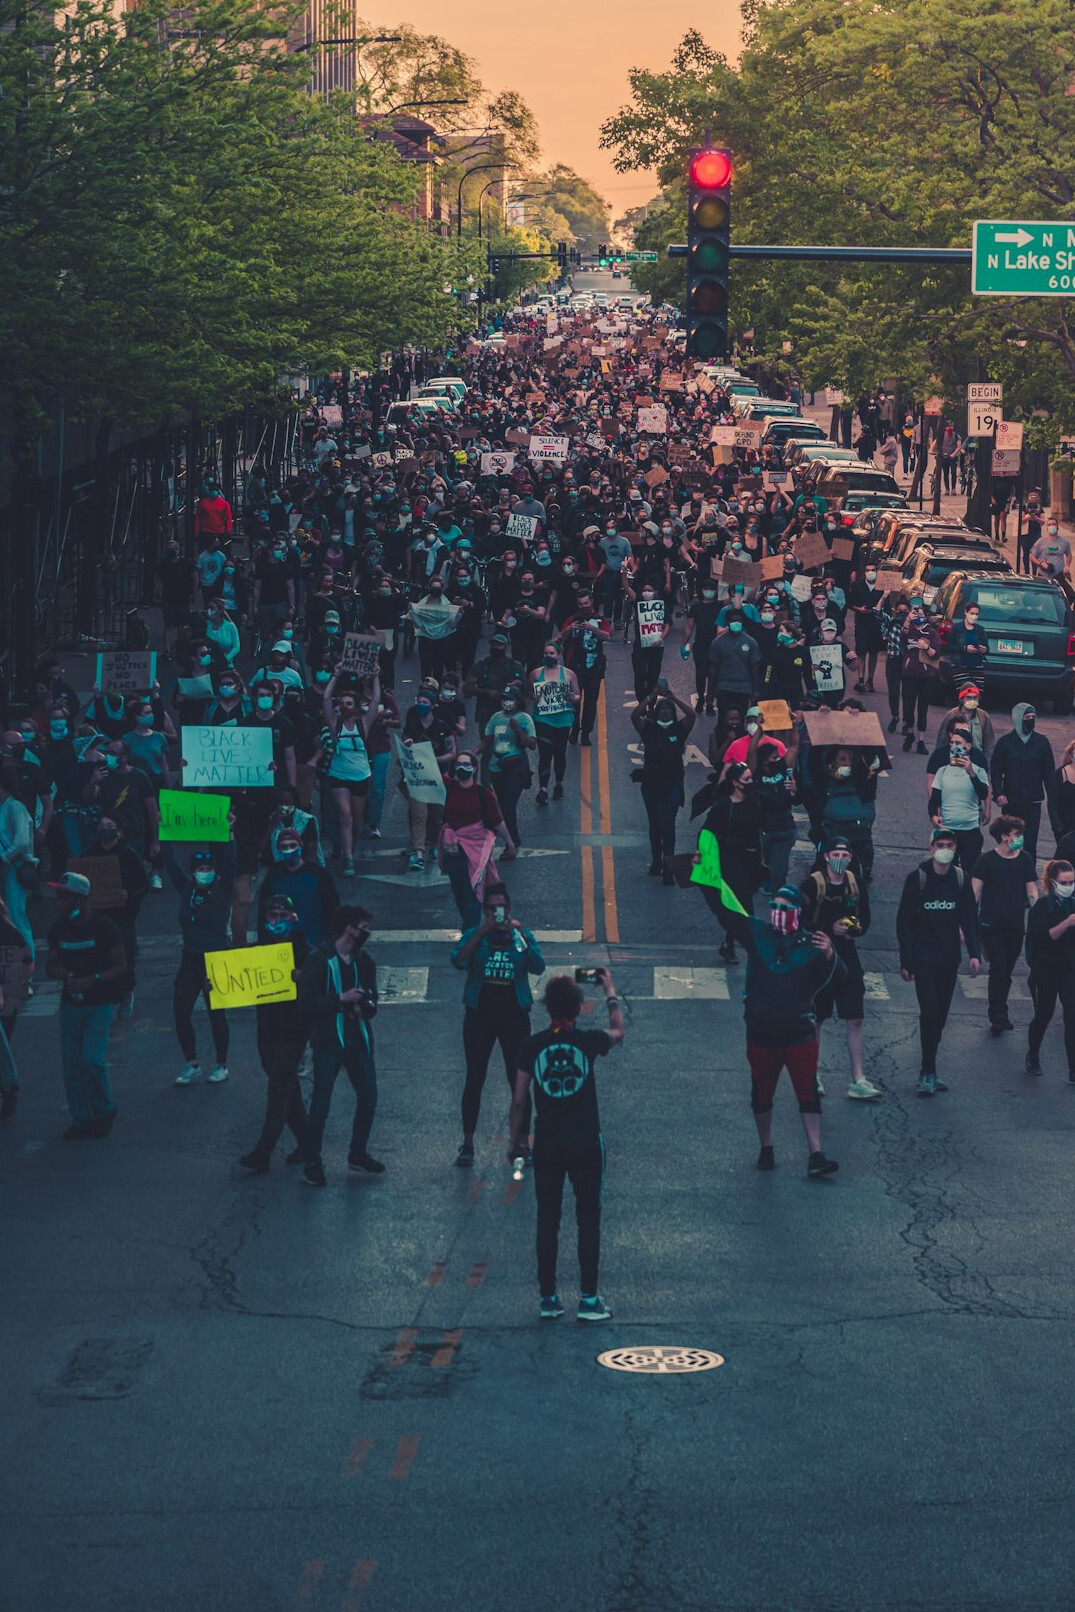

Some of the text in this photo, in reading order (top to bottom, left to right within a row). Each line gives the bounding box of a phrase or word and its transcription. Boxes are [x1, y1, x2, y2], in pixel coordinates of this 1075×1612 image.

[1042, 232, 1053, 247] N
[987, 254, 998, 269] N
[1005, 250, 1051, 270] Lake
[971, 387, 999, 397] BEGIN
[976, 416, 994, 430] 19
[539, 437, 565, 445] SILENCE
[736, 438, 752, 446] CPD
[512, 521, 532, 530] LIVES
[513, 515, 532, 524] BLACK
[507, 526, 531, 538] MATTER
[639, 601, 664, 613] BLACK
[345, 638, 380, 652] BLACK
[115, 653, 130, 662] NO
[344, 649, 378, 664] LIVES
[104, 662, 148, 671] JUSTICE
[115, 671, 130, 679] NO
[199, 728, 253, 747] BLACK
[201, 749, 252, 764] LIVES
[193, 764, 268, 783] MATTER
[162, 803, 223, 828] I'm here!
[923, 899, 956, 911] adidas
